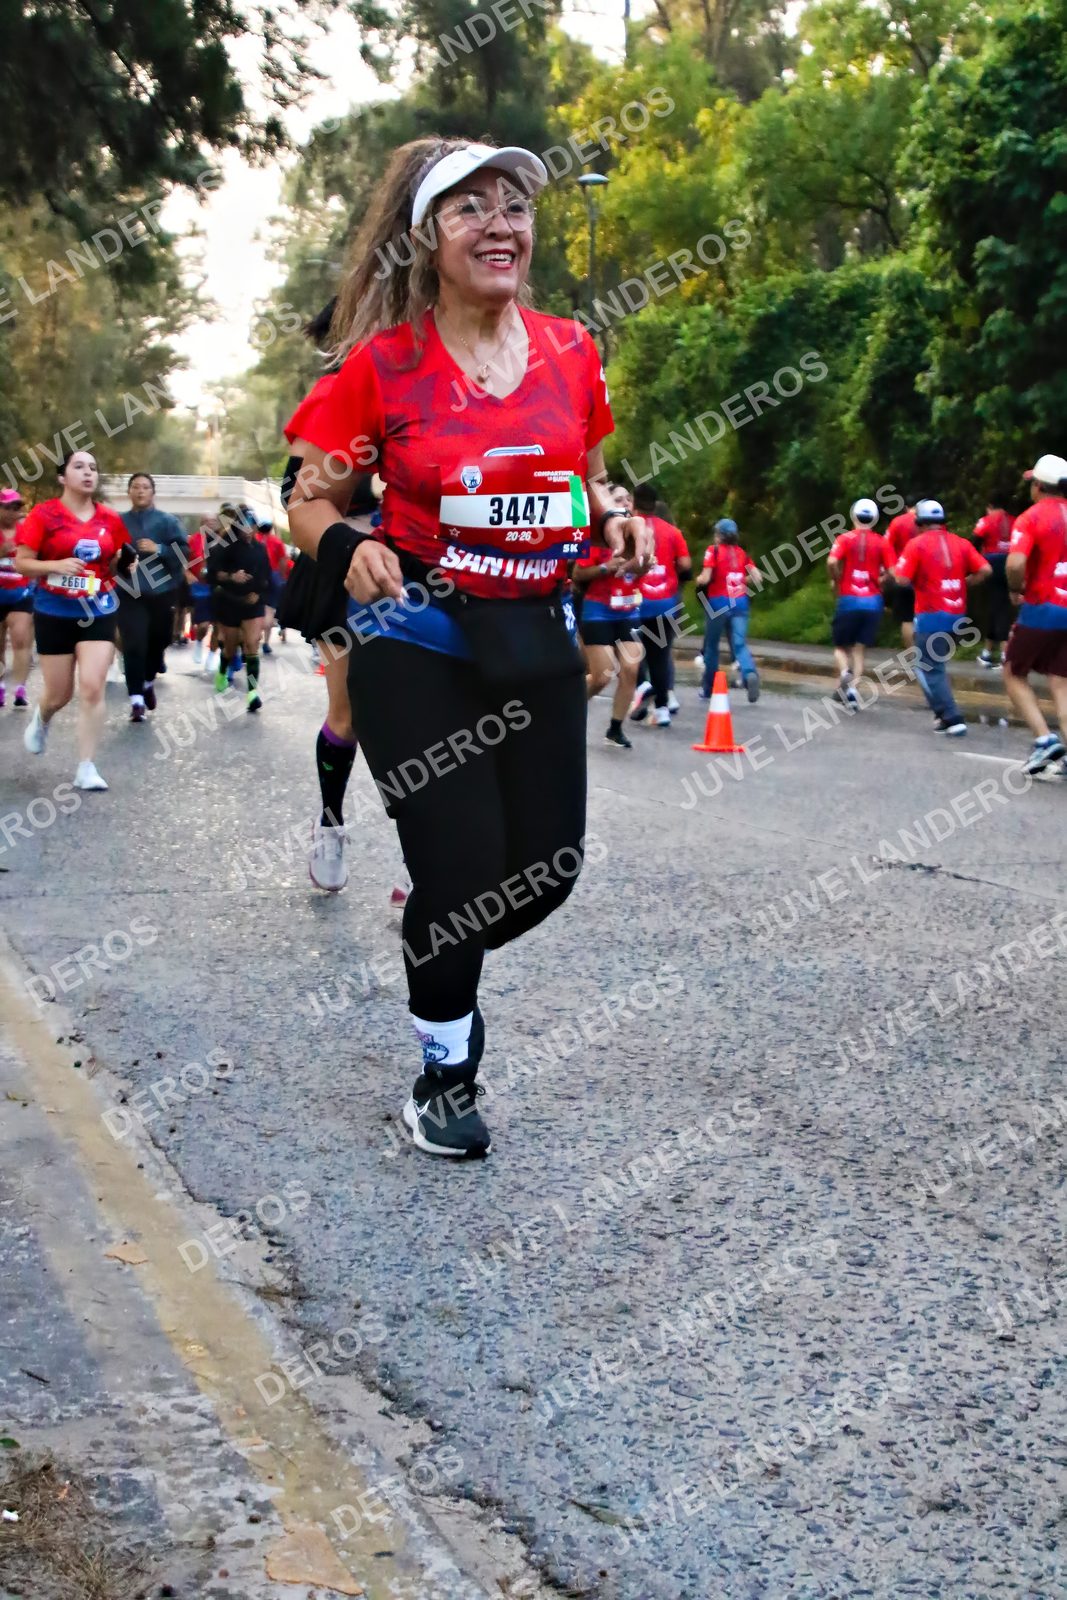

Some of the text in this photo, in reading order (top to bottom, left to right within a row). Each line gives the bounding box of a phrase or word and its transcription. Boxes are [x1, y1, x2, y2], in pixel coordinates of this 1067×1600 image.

[488, 496, 549, 526] 3447
[562, 543, 579, 553] 5K
[61, 575, 87, 589] 2660
